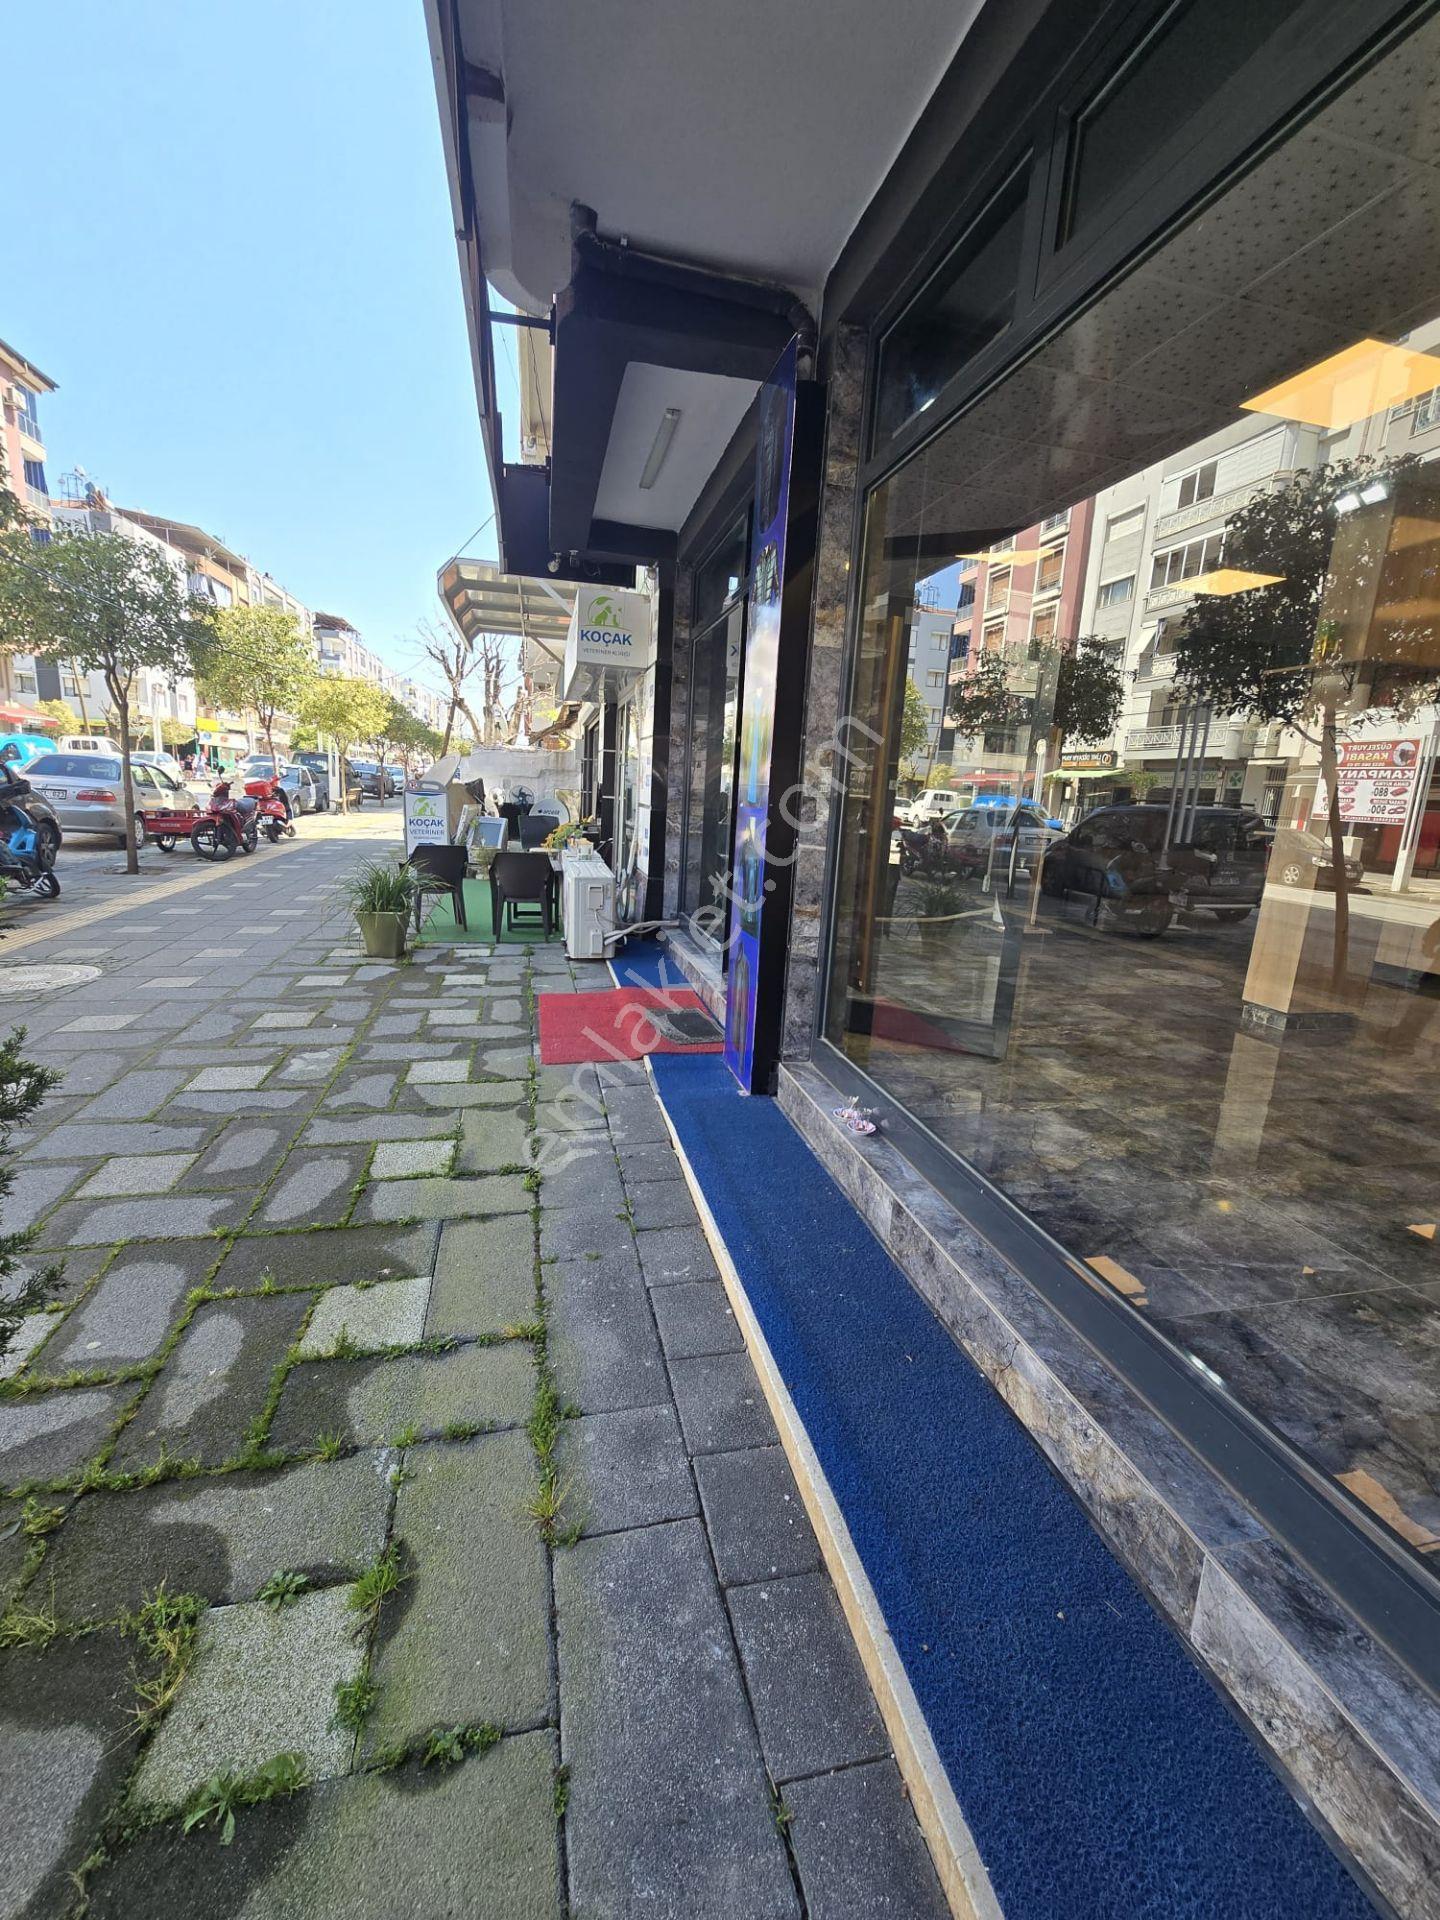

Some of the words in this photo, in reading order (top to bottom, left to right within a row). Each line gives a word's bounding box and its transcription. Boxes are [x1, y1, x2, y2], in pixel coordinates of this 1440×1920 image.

[580, 629, 632, 647] KOÇAK
[409, 818, 444, 828] KOÇAK
[410, 828, 444, 836] VETERİNER
